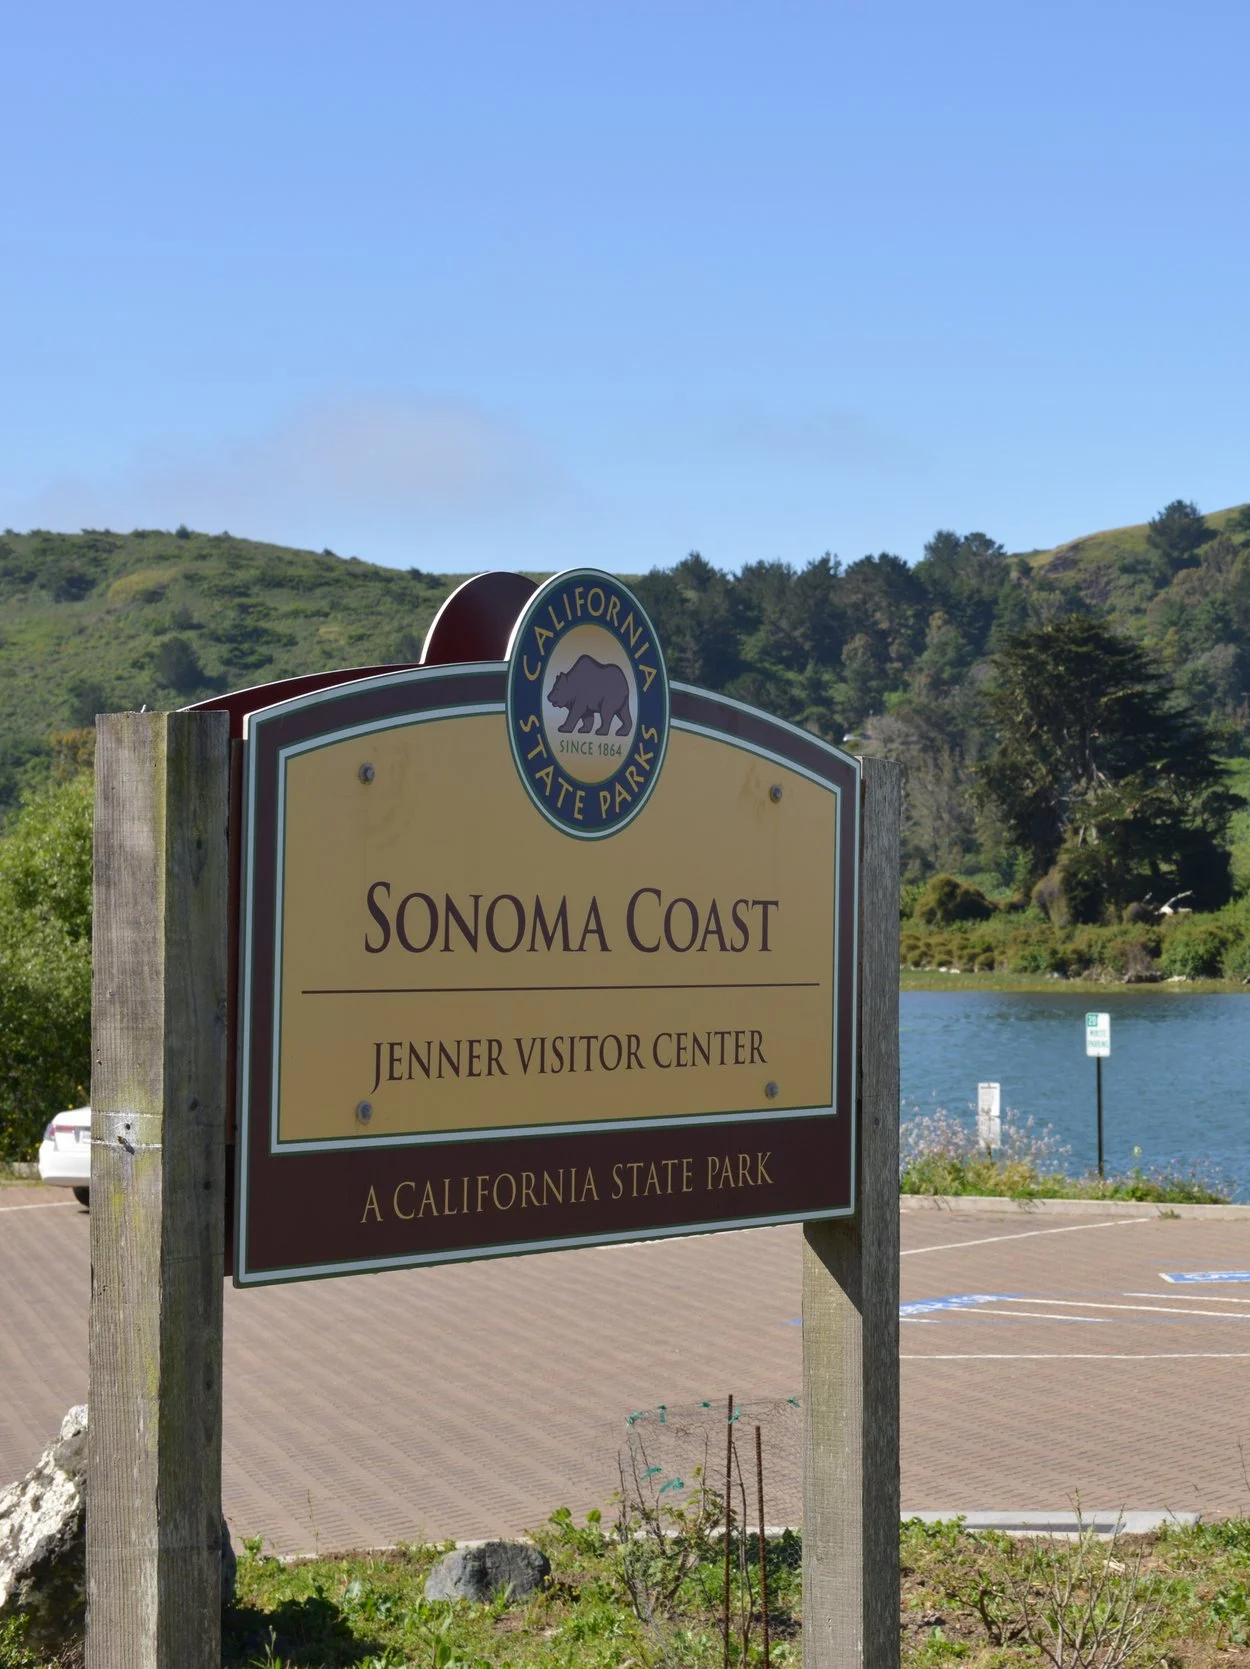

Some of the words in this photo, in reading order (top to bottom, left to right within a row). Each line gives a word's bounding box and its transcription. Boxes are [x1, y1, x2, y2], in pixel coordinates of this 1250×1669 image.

[523, 586, 657, 693] CALIFORNIA
[519, 714, 586, 821] STATE
[599, 724, 658, 819] PARKS
[559, 739, 594, 756] SINCE
[598, 742, 622, 757] 1864
[364, 881, 612, 954] SONOMA
[626, 887, 779, 953] COAST
[370, 1038, 508, 1095] JENNER
[513, 1034, 646, 1075] VISITOR
[652, 1030, 767, 1069] CENTER
[360, 1185, 384, 1223] A
[393, 1166, 599, 1220] CALIFORNIA
[611, 1158, 693, 1199] STATE
[706, 1151, 774, 1190] PARK
